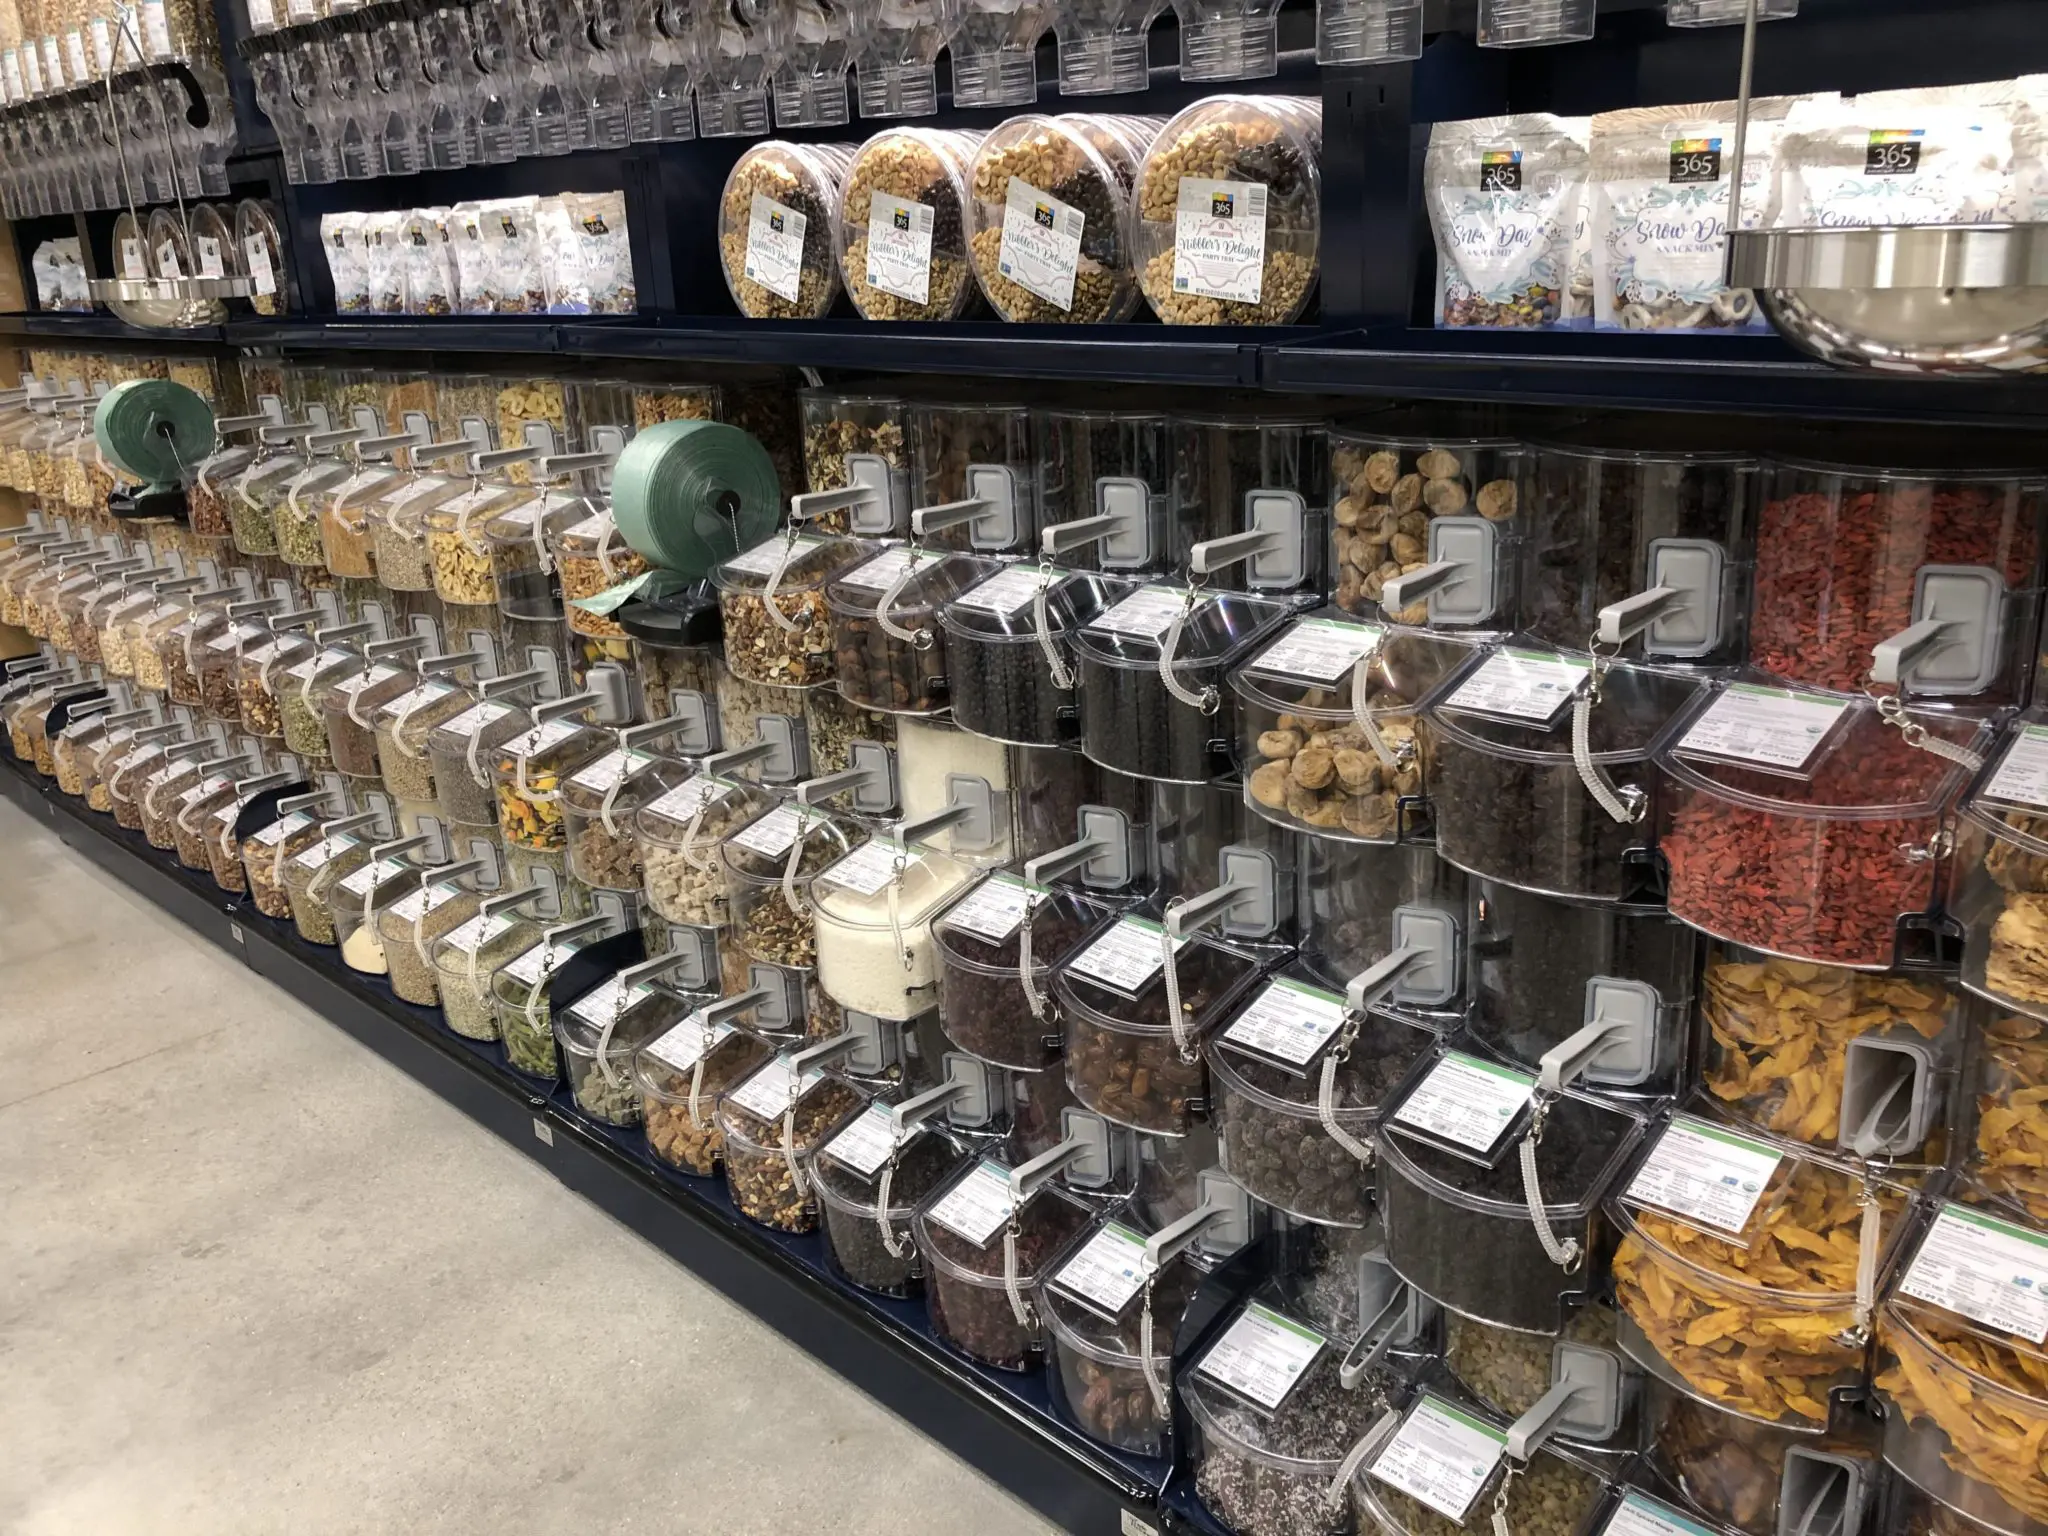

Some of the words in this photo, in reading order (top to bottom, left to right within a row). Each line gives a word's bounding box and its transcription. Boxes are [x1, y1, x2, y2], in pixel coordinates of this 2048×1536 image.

[1677, 154, 1712, 176] 365
[1873, 144, 1912, 168] 365
[1486, 165, 1515, 184] 365
[1215, 202, 1231, 214] 365
[1038, 211, 1051, 226] 365
[1637, 219, 1686, 244] Snow
[1690, 217, 1726, 242] Da
[1005, 229, 1040, 254] Nibbler's
[1042, 248, 1074, 275] Delight
[1180, 237, 1221, 252] Nibbler's
[1223, 240, 1261, 259] Delight
[1202, 253, 1220, 261] PARTY
[1656, 244, 1691, 253] SNACK
[1694, 243, 1714, 252] MIX
